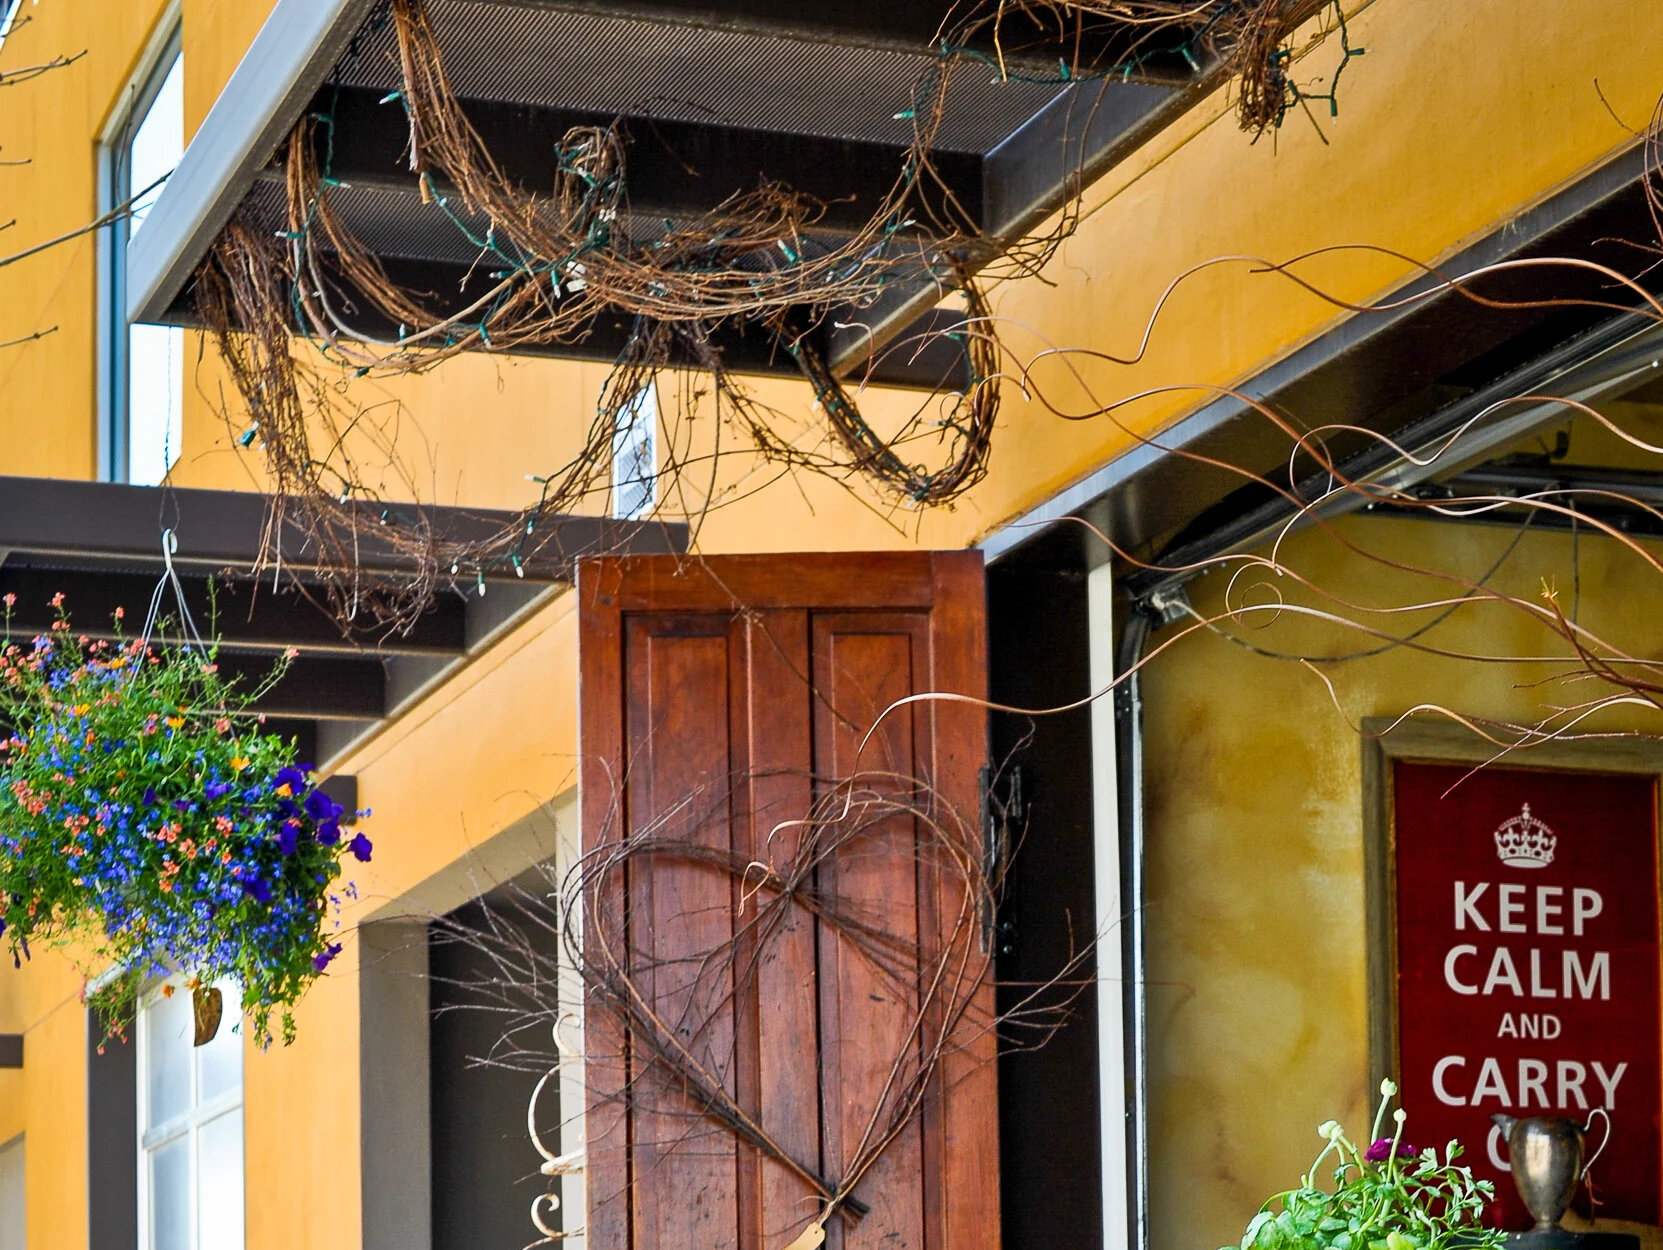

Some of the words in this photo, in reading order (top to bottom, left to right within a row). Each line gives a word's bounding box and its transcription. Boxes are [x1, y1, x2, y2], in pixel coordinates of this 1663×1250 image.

[1454, 881, 1603, 936] KEEP
[1444, 945, 1610, 1001] CALM
[1497, 1013, 1562, 1040] AND
[1432, 1055, 1628, 1111] CARRY
